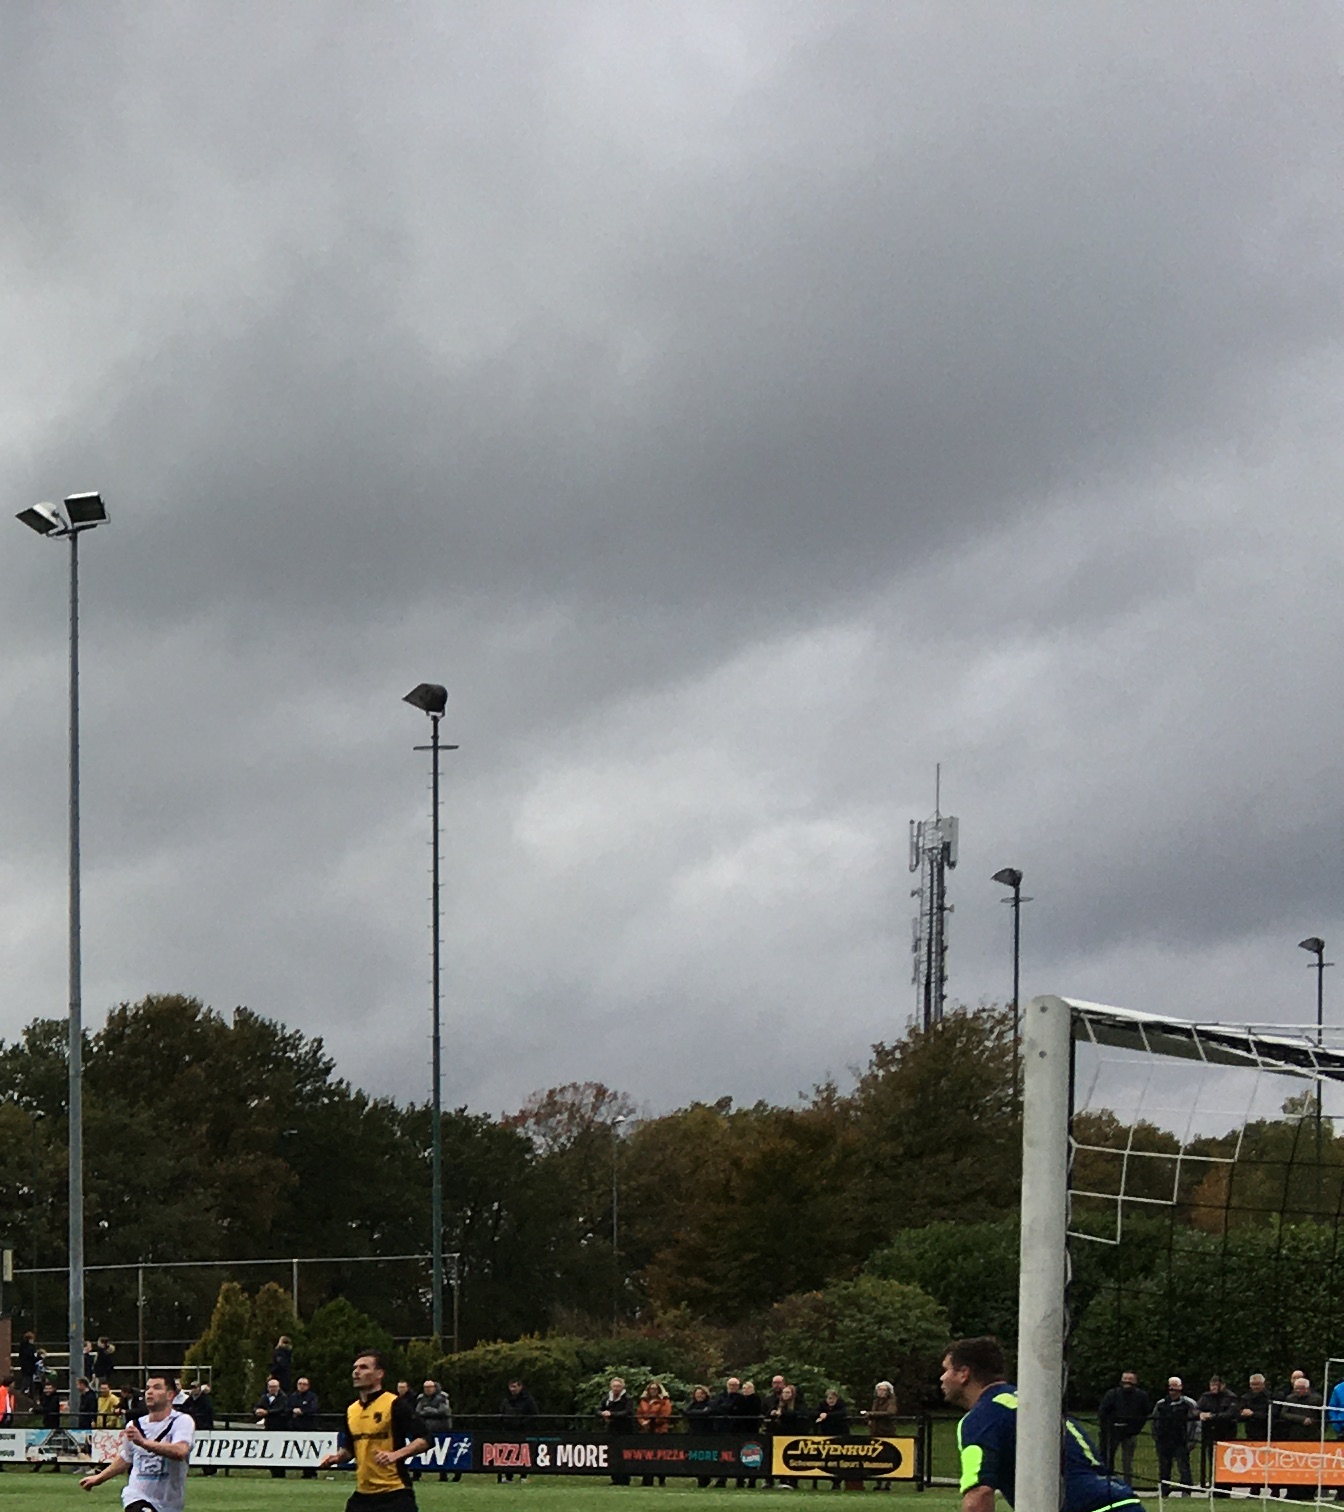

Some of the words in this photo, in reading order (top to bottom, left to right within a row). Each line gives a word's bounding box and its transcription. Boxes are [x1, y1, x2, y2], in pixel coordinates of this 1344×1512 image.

[482, 1442, 531, 1467] PIZZA
[536, 1443, 551, 1468] &
[556, 1444, 609, 1469] MORE
